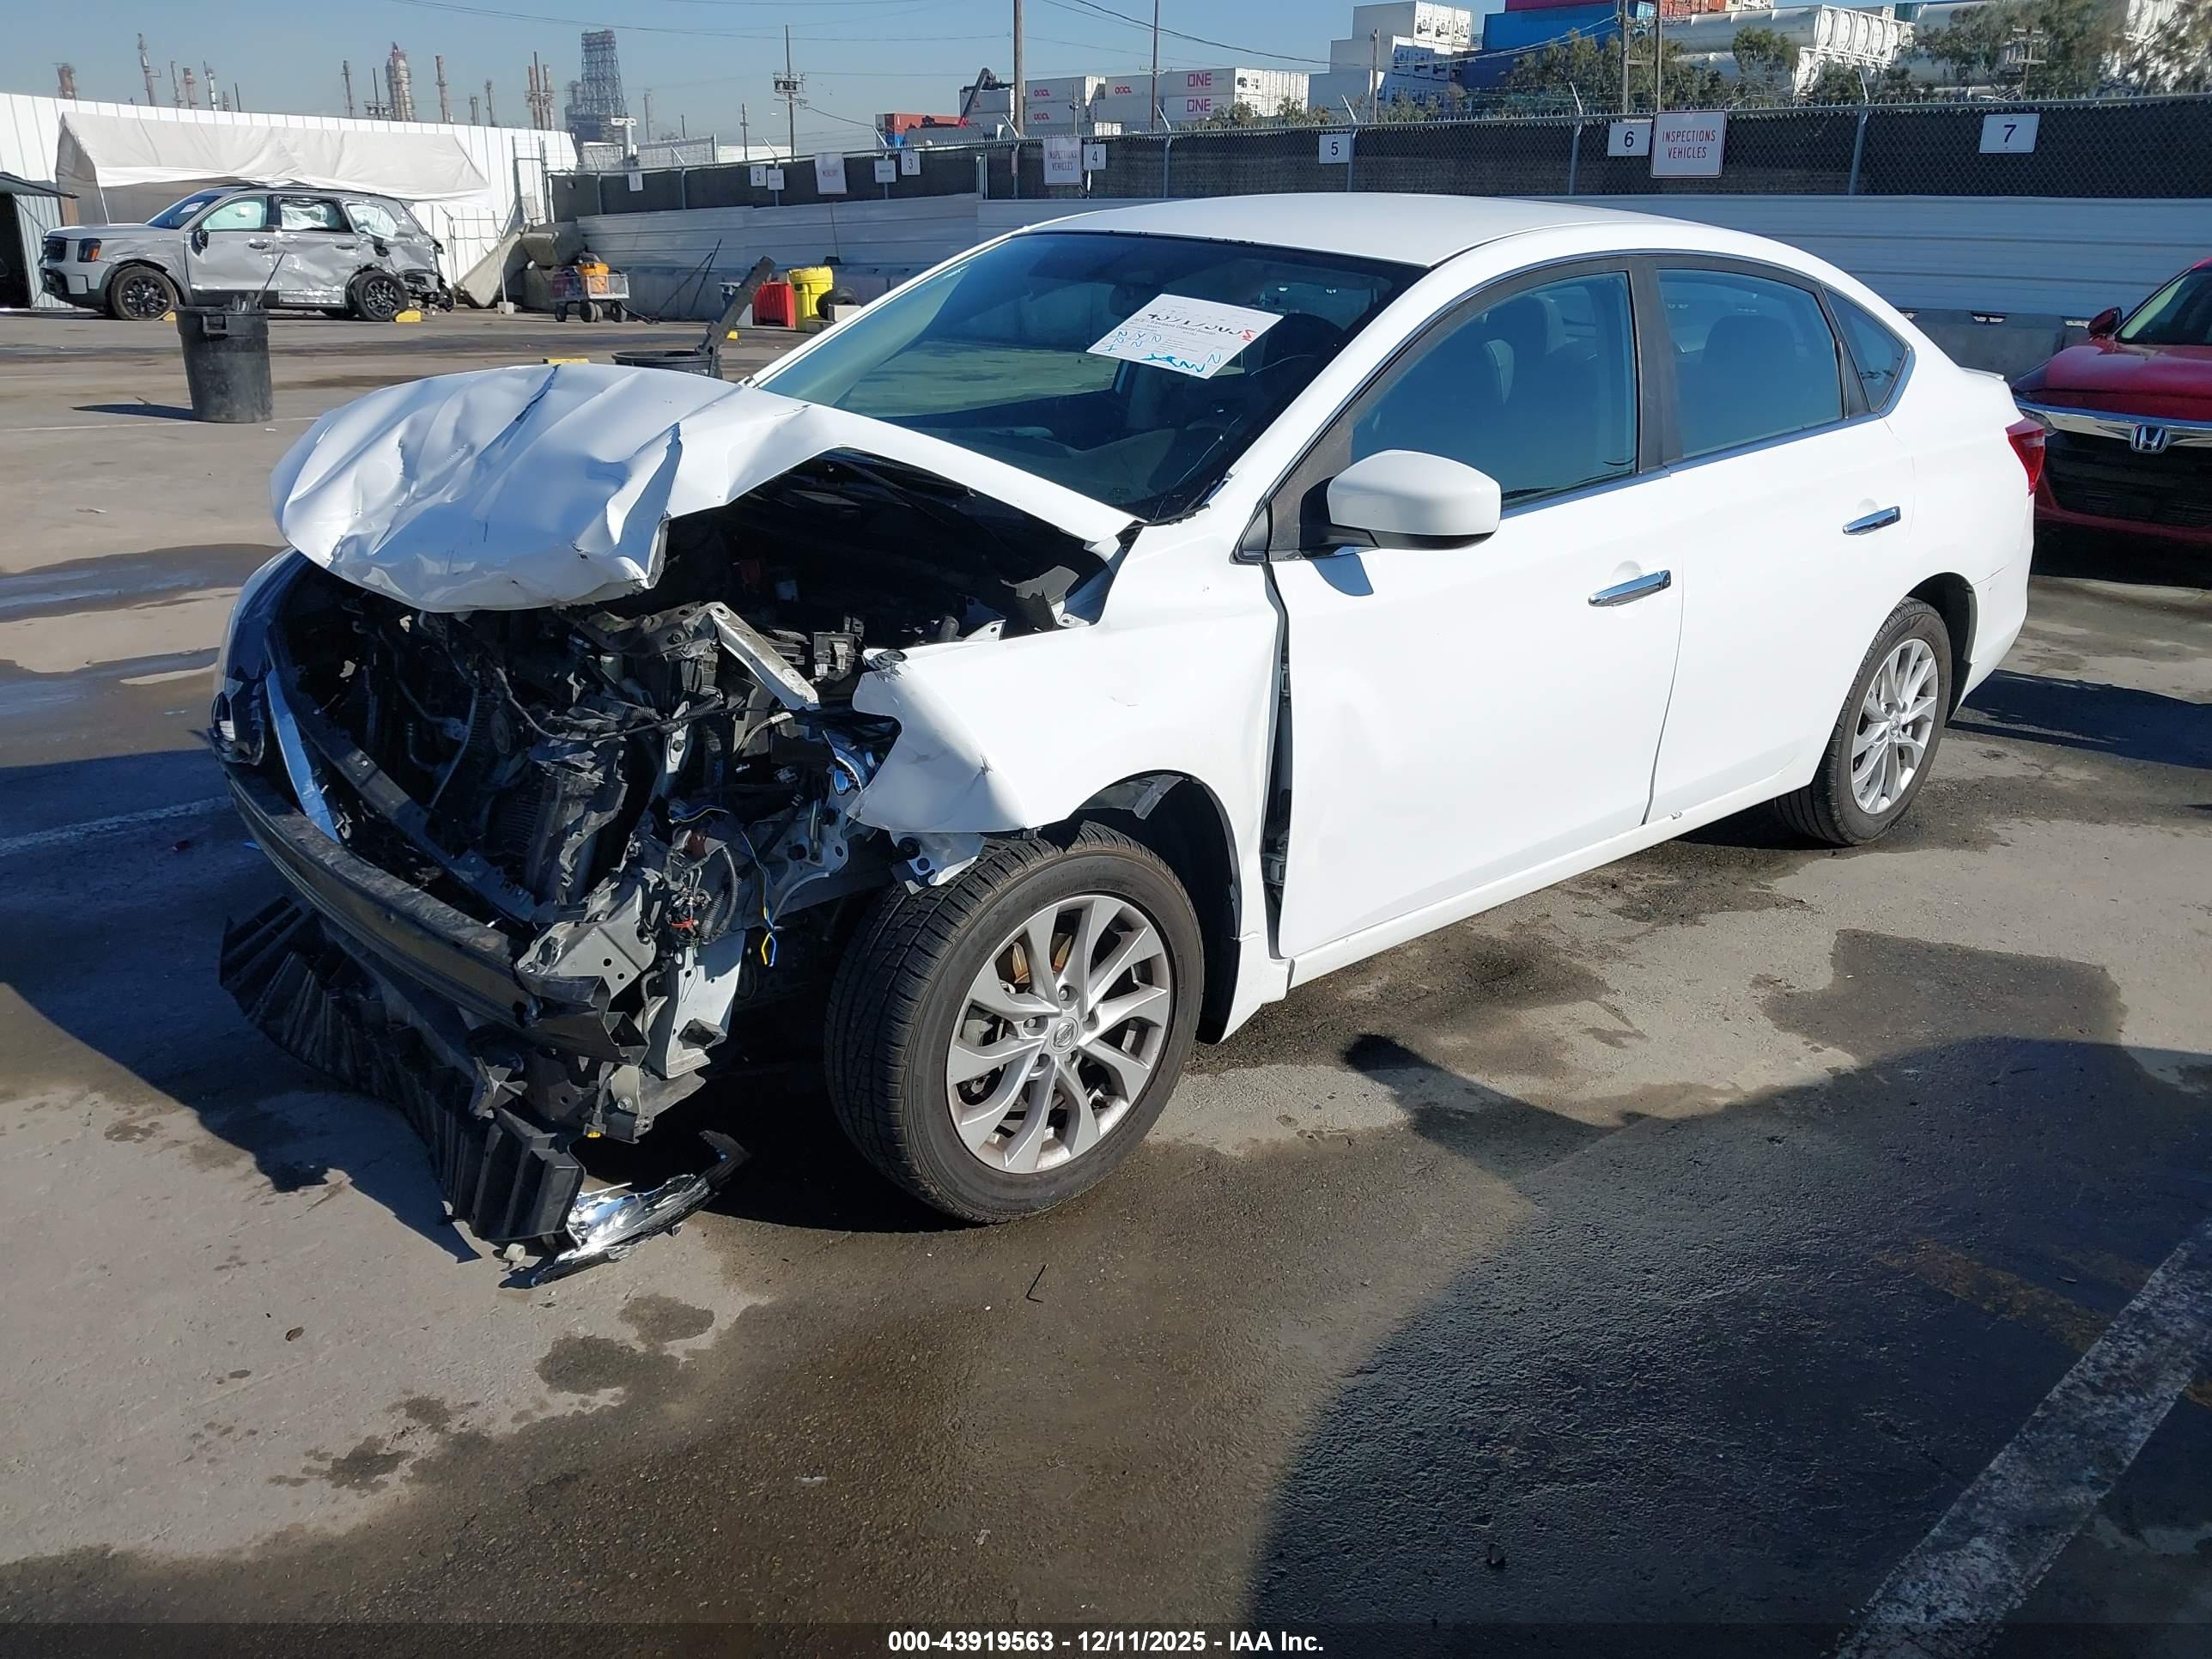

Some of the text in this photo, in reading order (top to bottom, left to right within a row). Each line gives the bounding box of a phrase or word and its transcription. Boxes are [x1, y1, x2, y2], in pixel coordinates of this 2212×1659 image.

[1187, 73, 1212, 87] ONE
[1187, 99, 1212, 112] ONE
[1624, 131, 1635, 148] 6
[1662, 130, 1717, 143] INSPECTIONS
[2003, 124, 2017, 143] 7
[1331, 142, 1339, 155] 5
[1668, 147, 1707, 159] VEHICLES
[1091, 150, 1098, 164] 4
[908, 157, 914, 171] 3
[756, 170, 762, 182] 2
